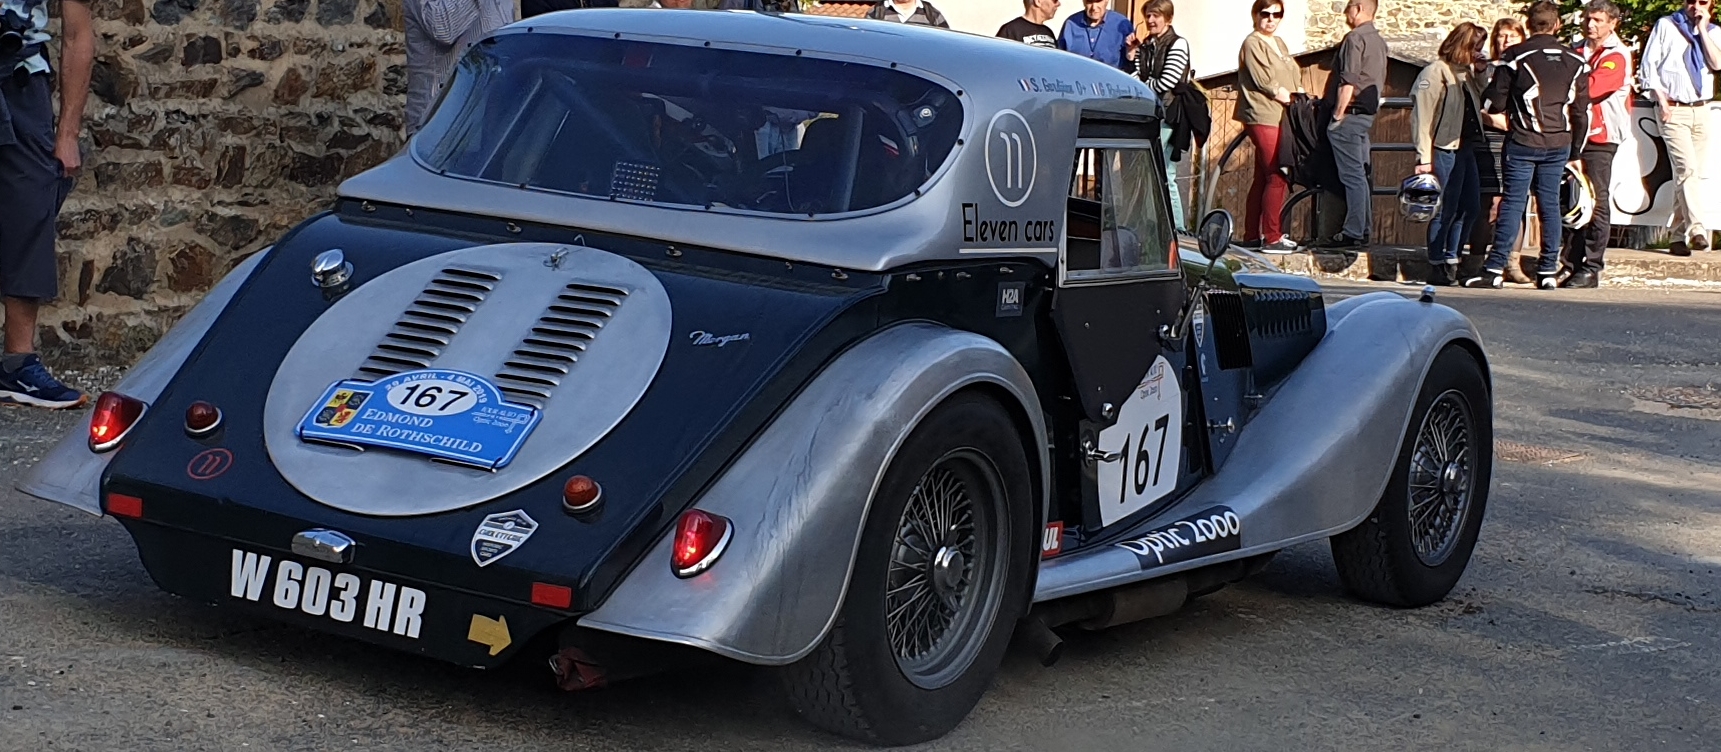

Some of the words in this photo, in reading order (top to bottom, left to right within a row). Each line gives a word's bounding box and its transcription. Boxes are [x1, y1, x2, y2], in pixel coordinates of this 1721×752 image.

[1000, 131, 1022, 188] 11
[962, 203, 1018, 242] Eleven
[1025, 220, 1055, 242] cars
[1002, 288, 1019, 304] H2A
[689, 330, 750, 347] Morgan
[400, 383, 470, 411] 167
[403, 372, 438, 383] AVRIL
[459, 376, 475, 387] MAI
[472, 384, 488, 404] 2019
[361, 408, 434, 428] EDMOND
[350, 422, 375, 435] DE
[378, 426, 483, 453] ROTHSCHILD
[1119, 413, 1170, 504] 167
[1114, 527, 1190, 564] Optic
[1175, 511, 1241, 543] 2000
[231, 548, 272, 601] W
[273, 560, 361, 623] 603
[363, 579, 427, 639] HR
